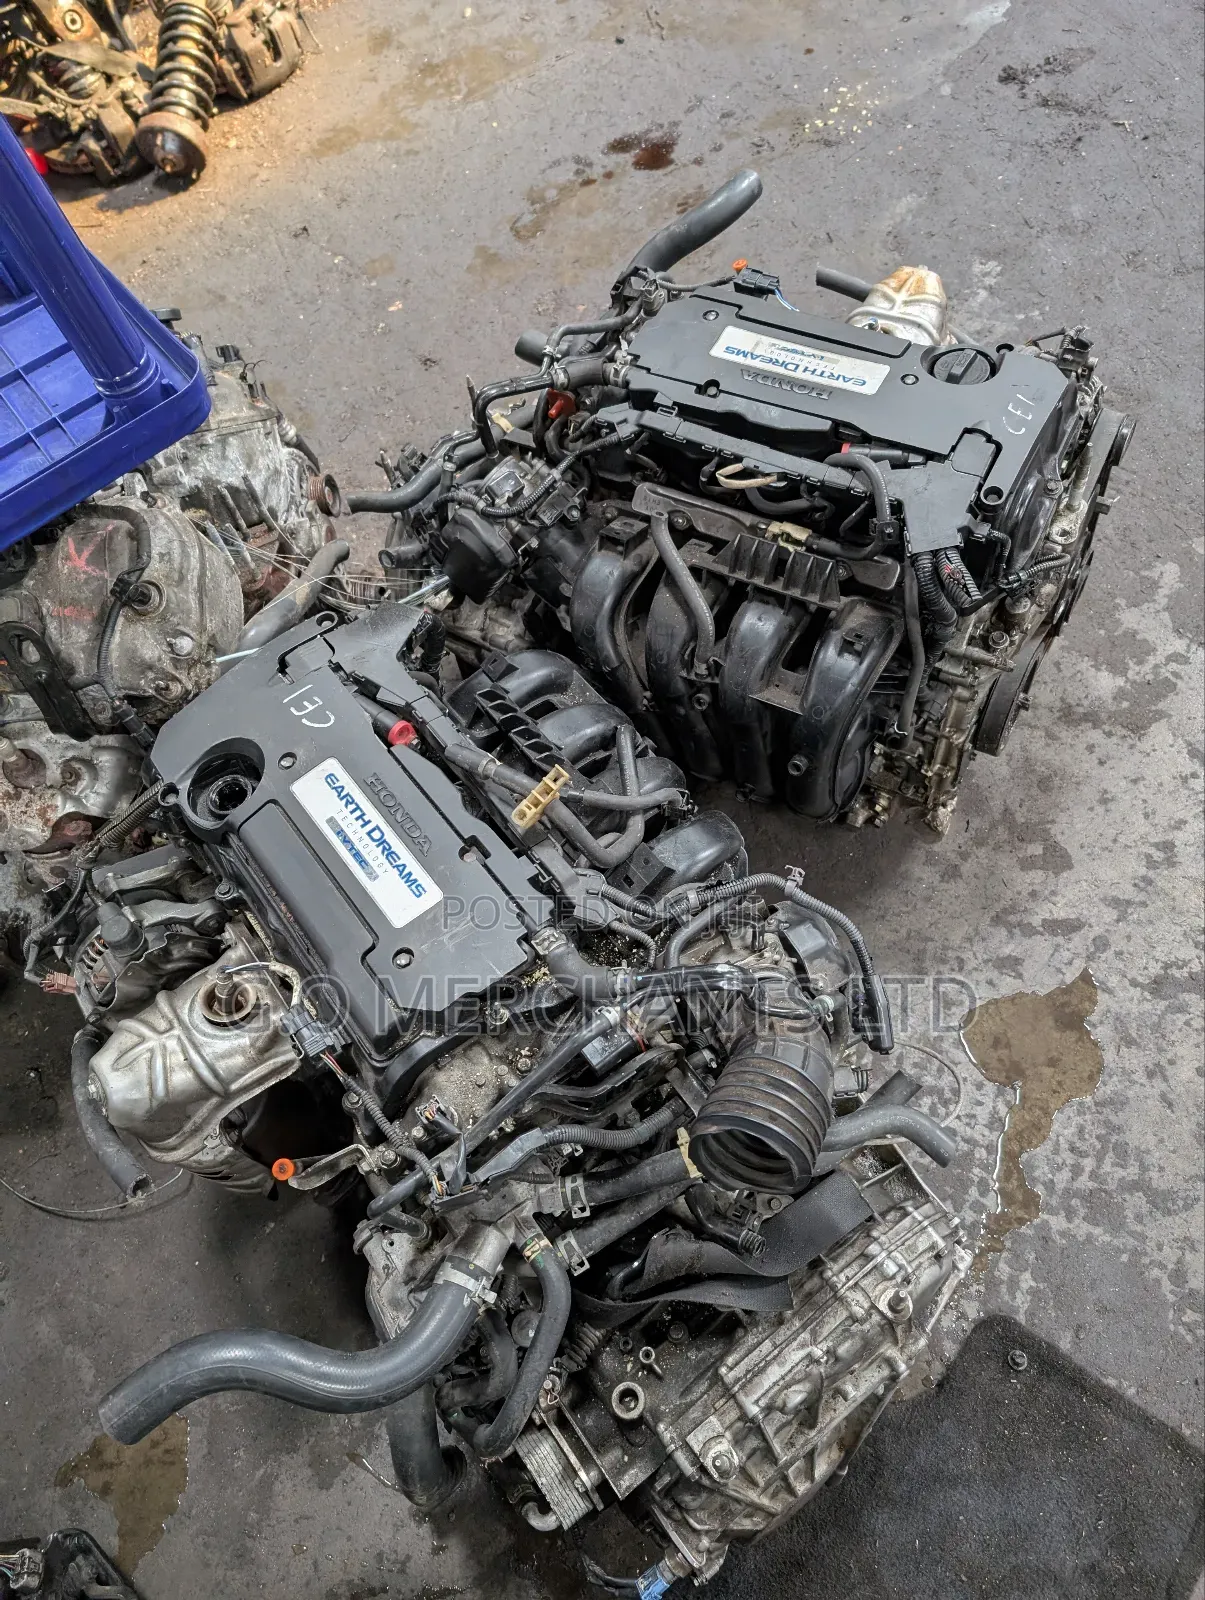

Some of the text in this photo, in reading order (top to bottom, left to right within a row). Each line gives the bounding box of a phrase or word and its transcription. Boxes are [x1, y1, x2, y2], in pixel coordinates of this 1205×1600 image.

[723, 345, 799, 372] DREAMS
[799, 366, 867, 387] EARTH
[740, 368, 834, 401] HONDA
[324, 772, 427, 899] EARTH DREAMS
[363, 772, 433, 857] HONDA
[336, 808, 389, 874] TECHNOLOGY
